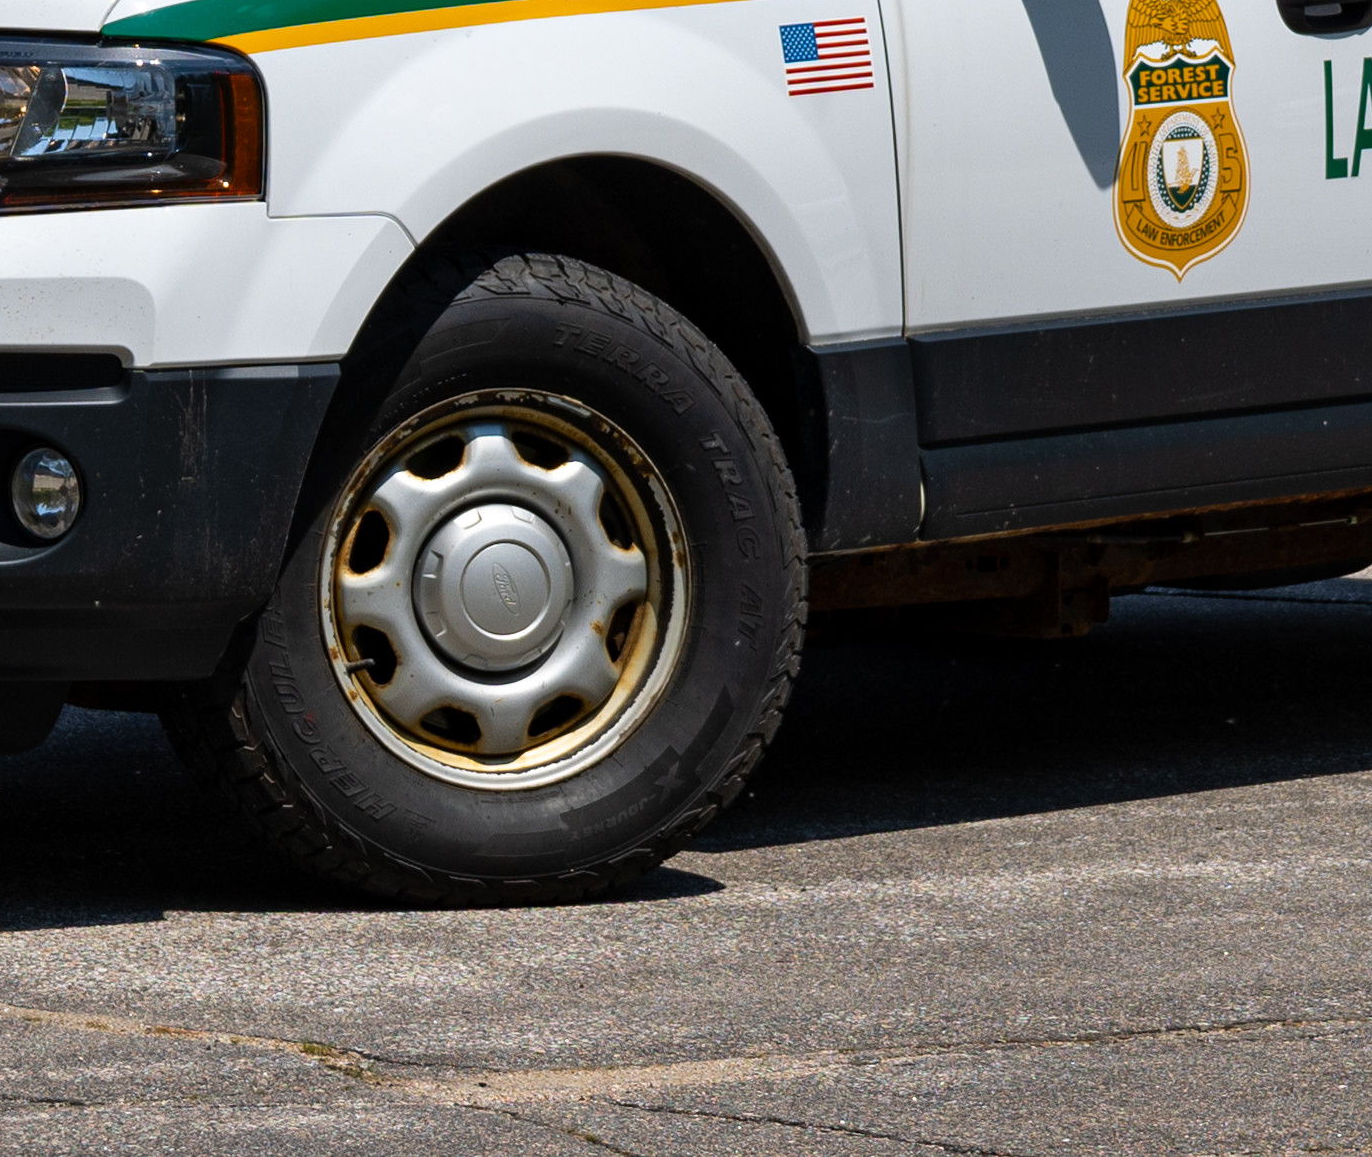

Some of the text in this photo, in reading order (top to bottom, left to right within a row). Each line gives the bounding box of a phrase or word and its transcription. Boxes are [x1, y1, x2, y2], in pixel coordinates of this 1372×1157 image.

[1138, 64, 1221, 87] FOREST
[1137, 80, 1225, 104] SERVICE
[1136, 210, 1226, 247] LAW ENFORCEMENT
[551, 322, 696, 417] TERRA
[698, 430, 762, 562] TRAC
